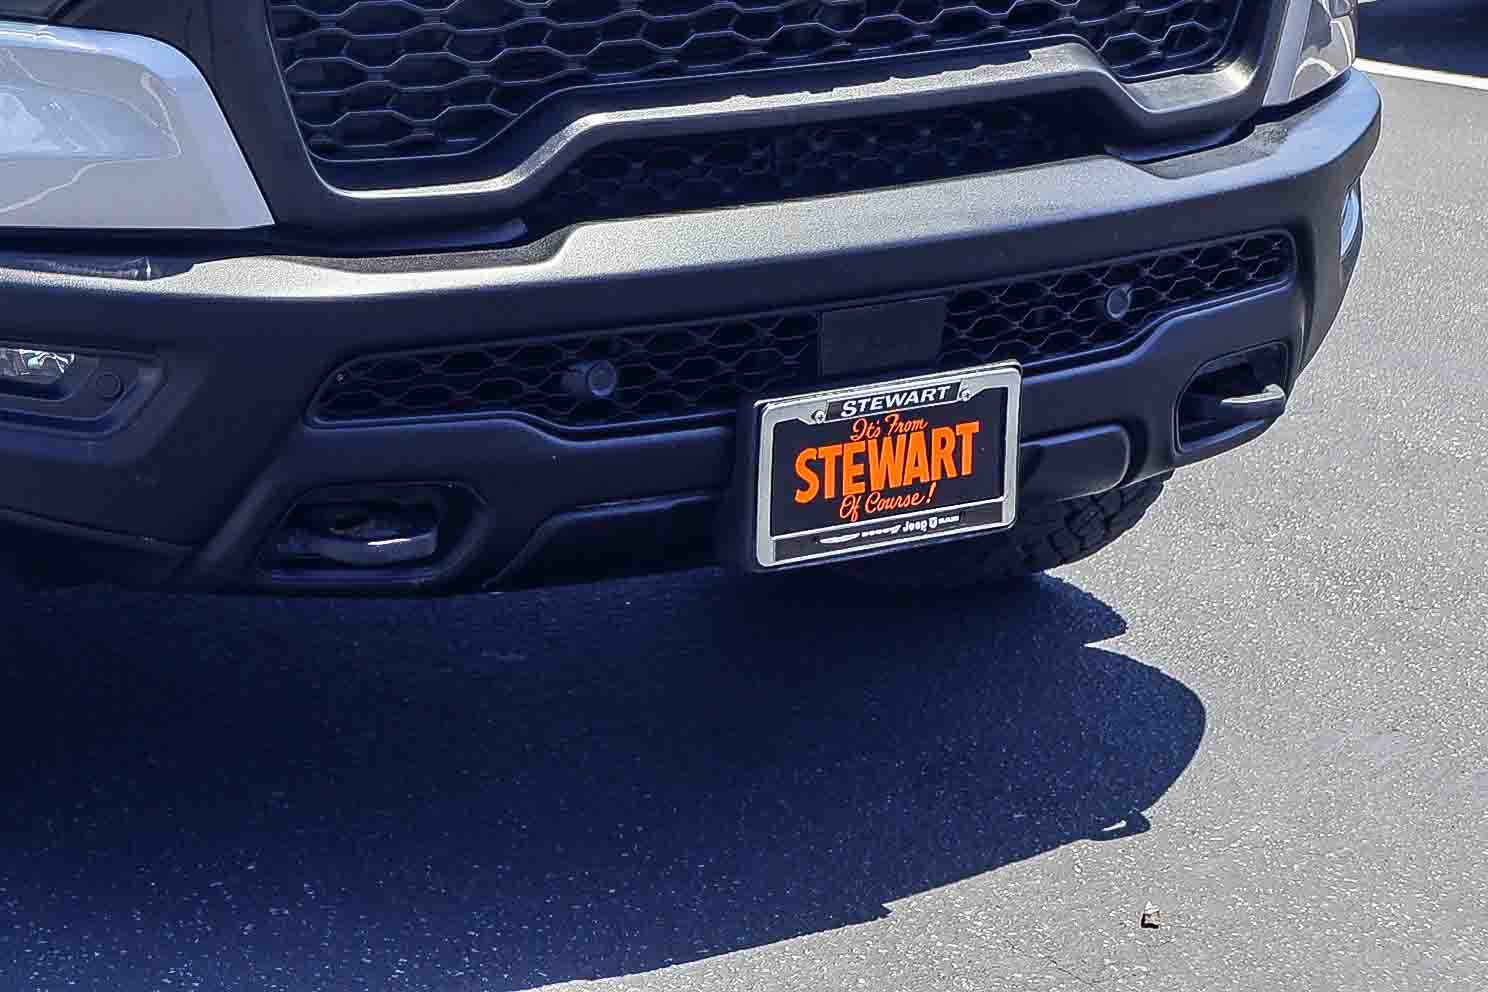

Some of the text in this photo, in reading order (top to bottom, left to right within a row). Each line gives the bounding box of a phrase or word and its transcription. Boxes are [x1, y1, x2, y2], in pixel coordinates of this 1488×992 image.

[840, 385, 951, 418] STEWART
[849, 413, 928, 441] It's From
[794, 421, 981, 504] STEWART
[839, 493, 863, 522] Of
[902, 519, 927, 533] Jeep
